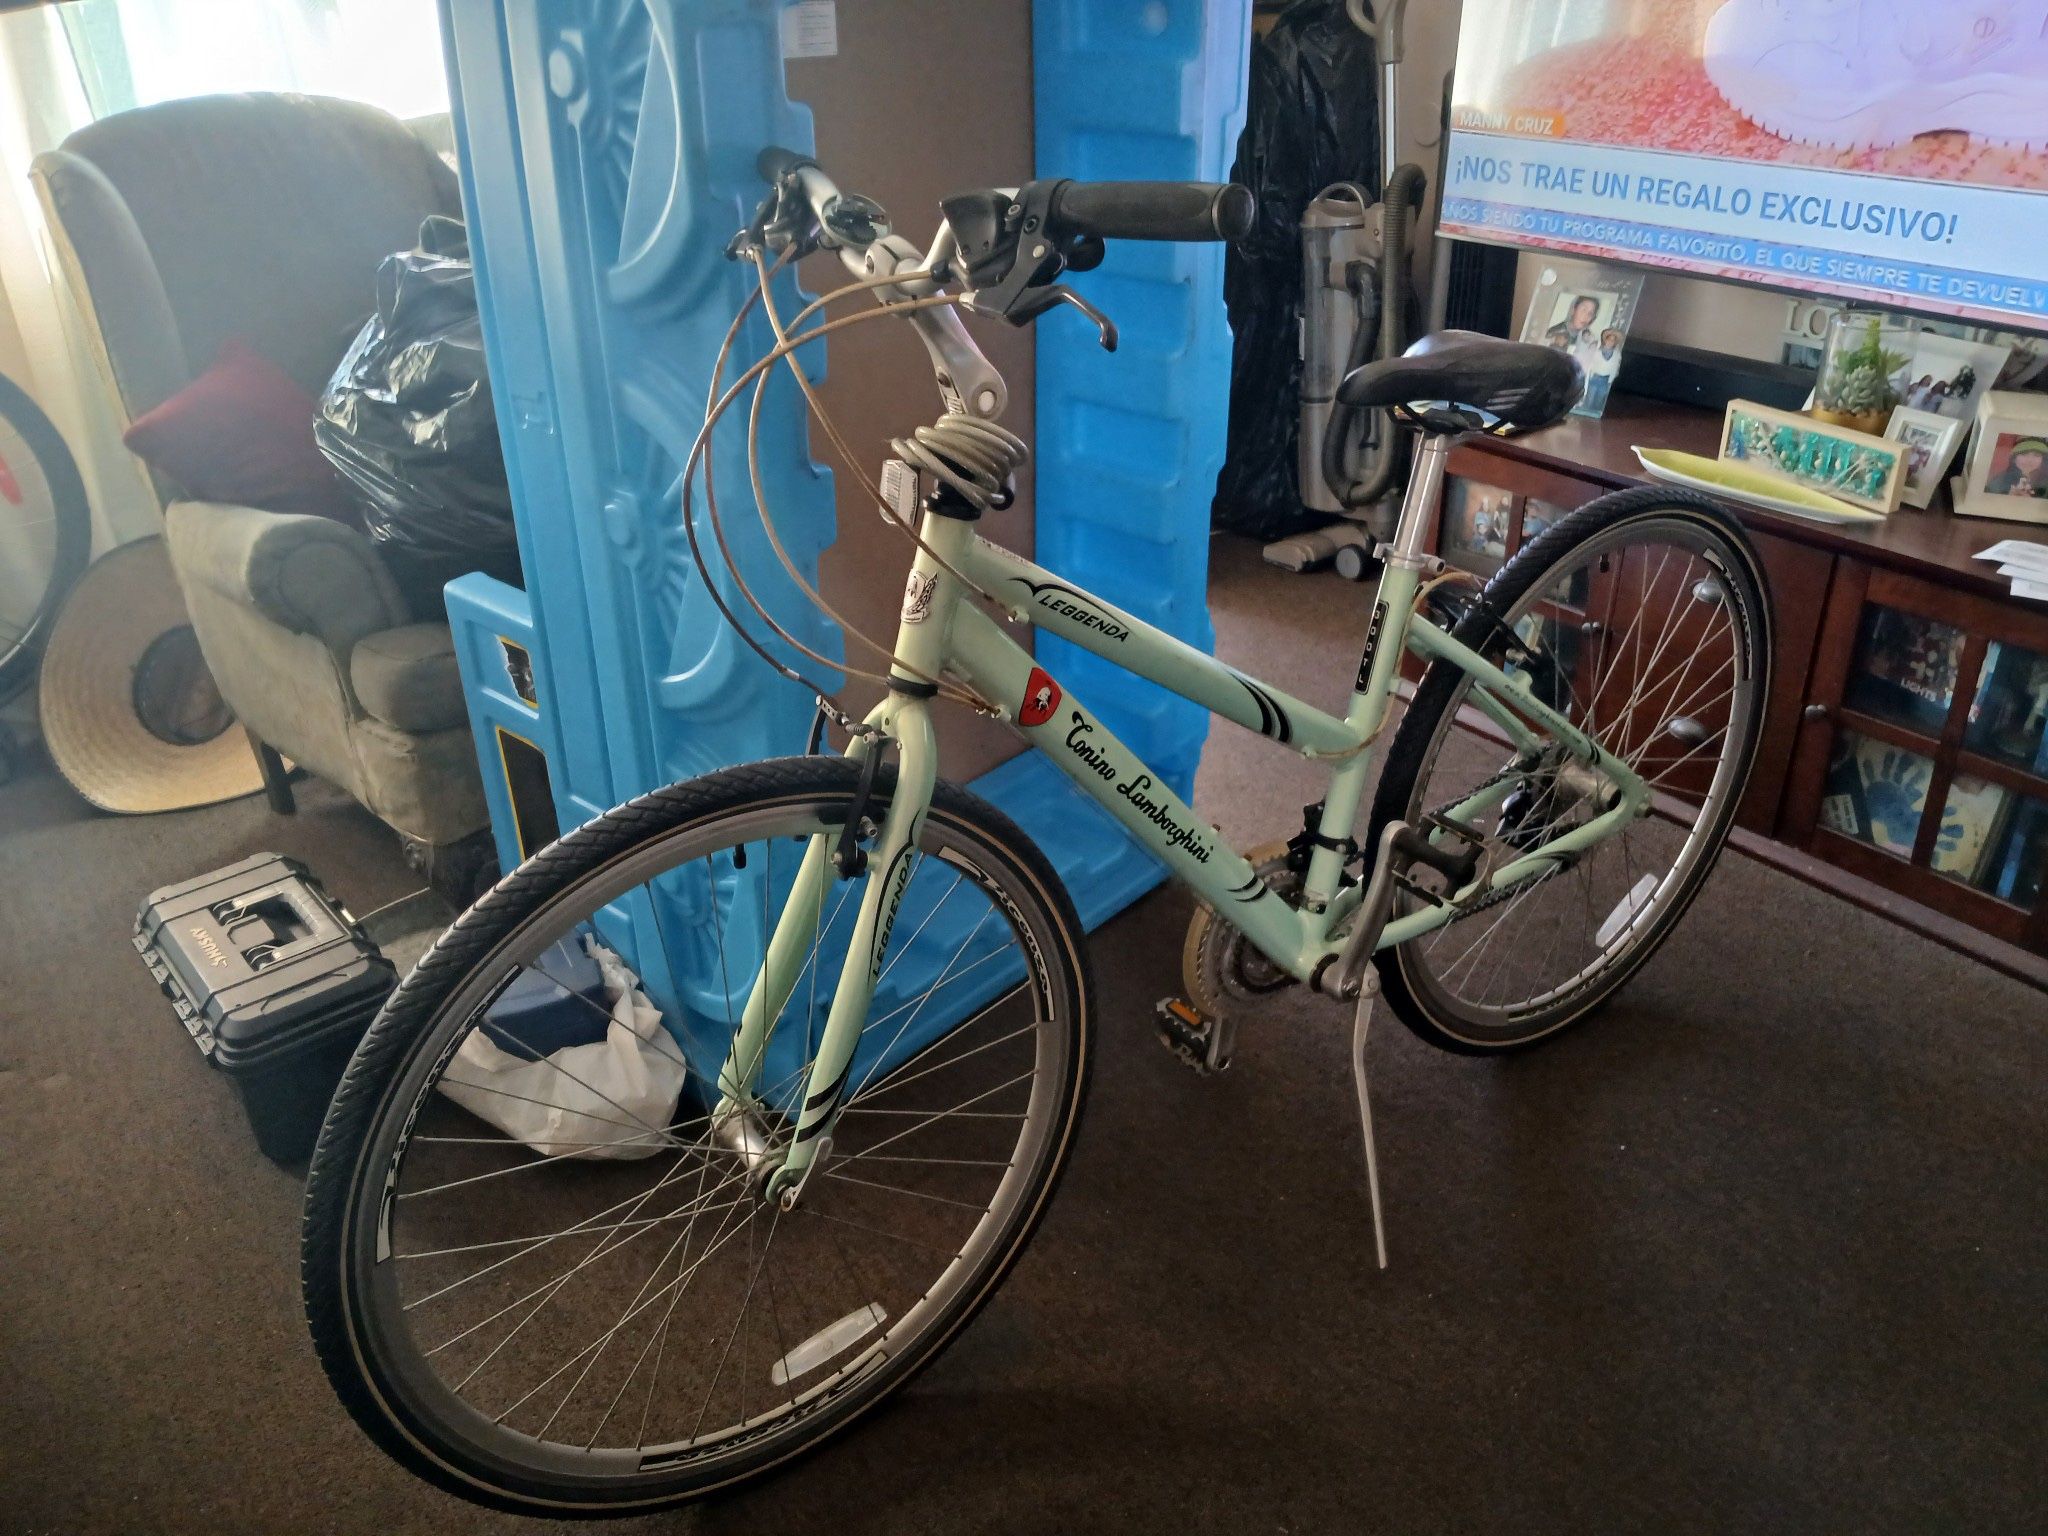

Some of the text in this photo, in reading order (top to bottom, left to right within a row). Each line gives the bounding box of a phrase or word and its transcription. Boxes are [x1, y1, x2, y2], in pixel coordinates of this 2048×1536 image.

[1459, 112, 1555, 134] MANNY CRUZ
[1456, 156, 1958, 244] ¡NOS TRAE UN REGALO EXCLUSIVO!
[1482, 207, 1536, 229] SIENDO
[1540, 216, 1560, 233] TU
[1562, 220, 1652, 248] PROGRAMA
[1657, 233, 1749, 265] FAVORITO,
[1754, 248, 1776, 268] EL
[1780, 252, 1822, 275] QUE
[1826, 258, 1909, 289] SIEMPRE
[1917, 272, 1942, 294] TE
[1038, 594, 1129, 642] LEGGENDA
[1065, 711, 1214, 863] Tonino Lamborghini
[872, 853, 913, 977] LEGGENDA
